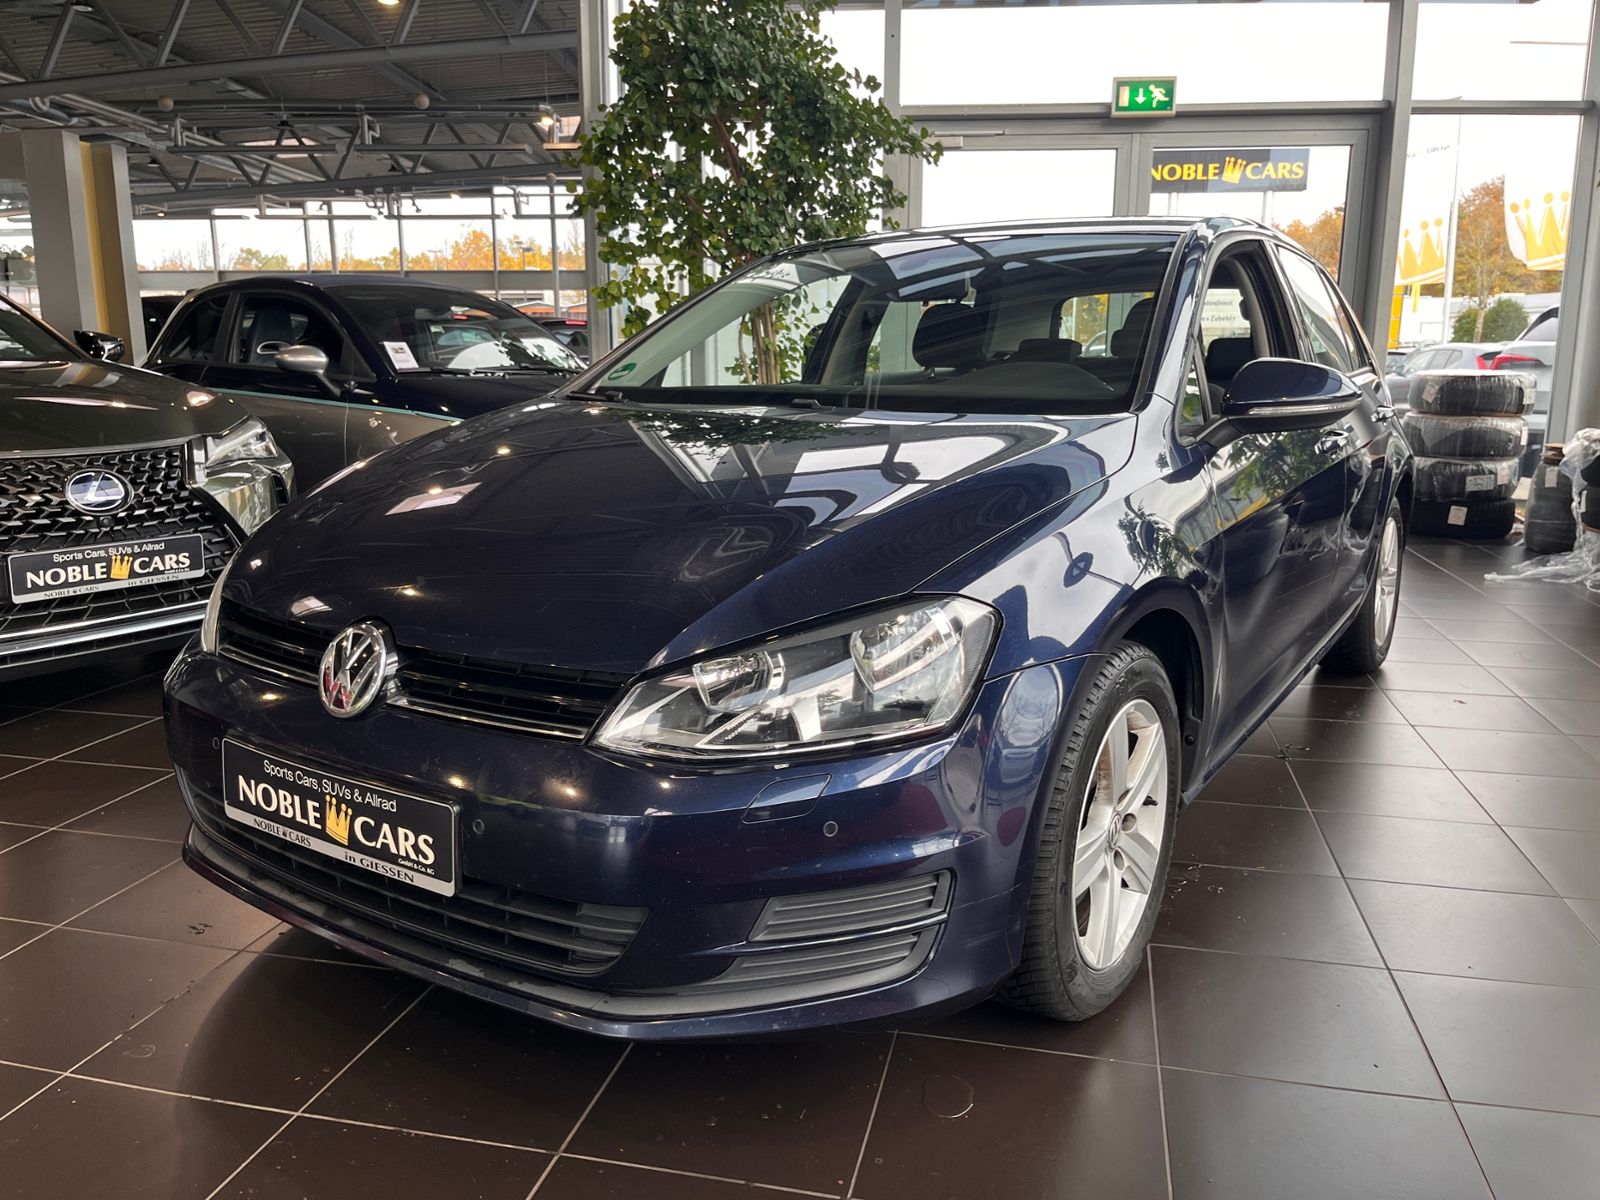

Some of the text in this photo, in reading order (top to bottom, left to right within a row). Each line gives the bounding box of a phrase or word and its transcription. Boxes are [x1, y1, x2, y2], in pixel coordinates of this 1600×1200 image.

[1151, 162, 1305, 181] NOBLE CARS
[53, 542, 165, 563] Sports Cars, SUVs & Allrad
[26, 552, 191, 588] NOBLE CARS
[44, 590, 70, 599] NOBLE
[263, 760, 397, 813] Sports Cars, SUVs & Allrad
[238, 775, 435, 865] NOBLE CARS
[254, 818, 311, 847] NOBLE CARS
[345, 852, 415, 884] in GIESSEN
